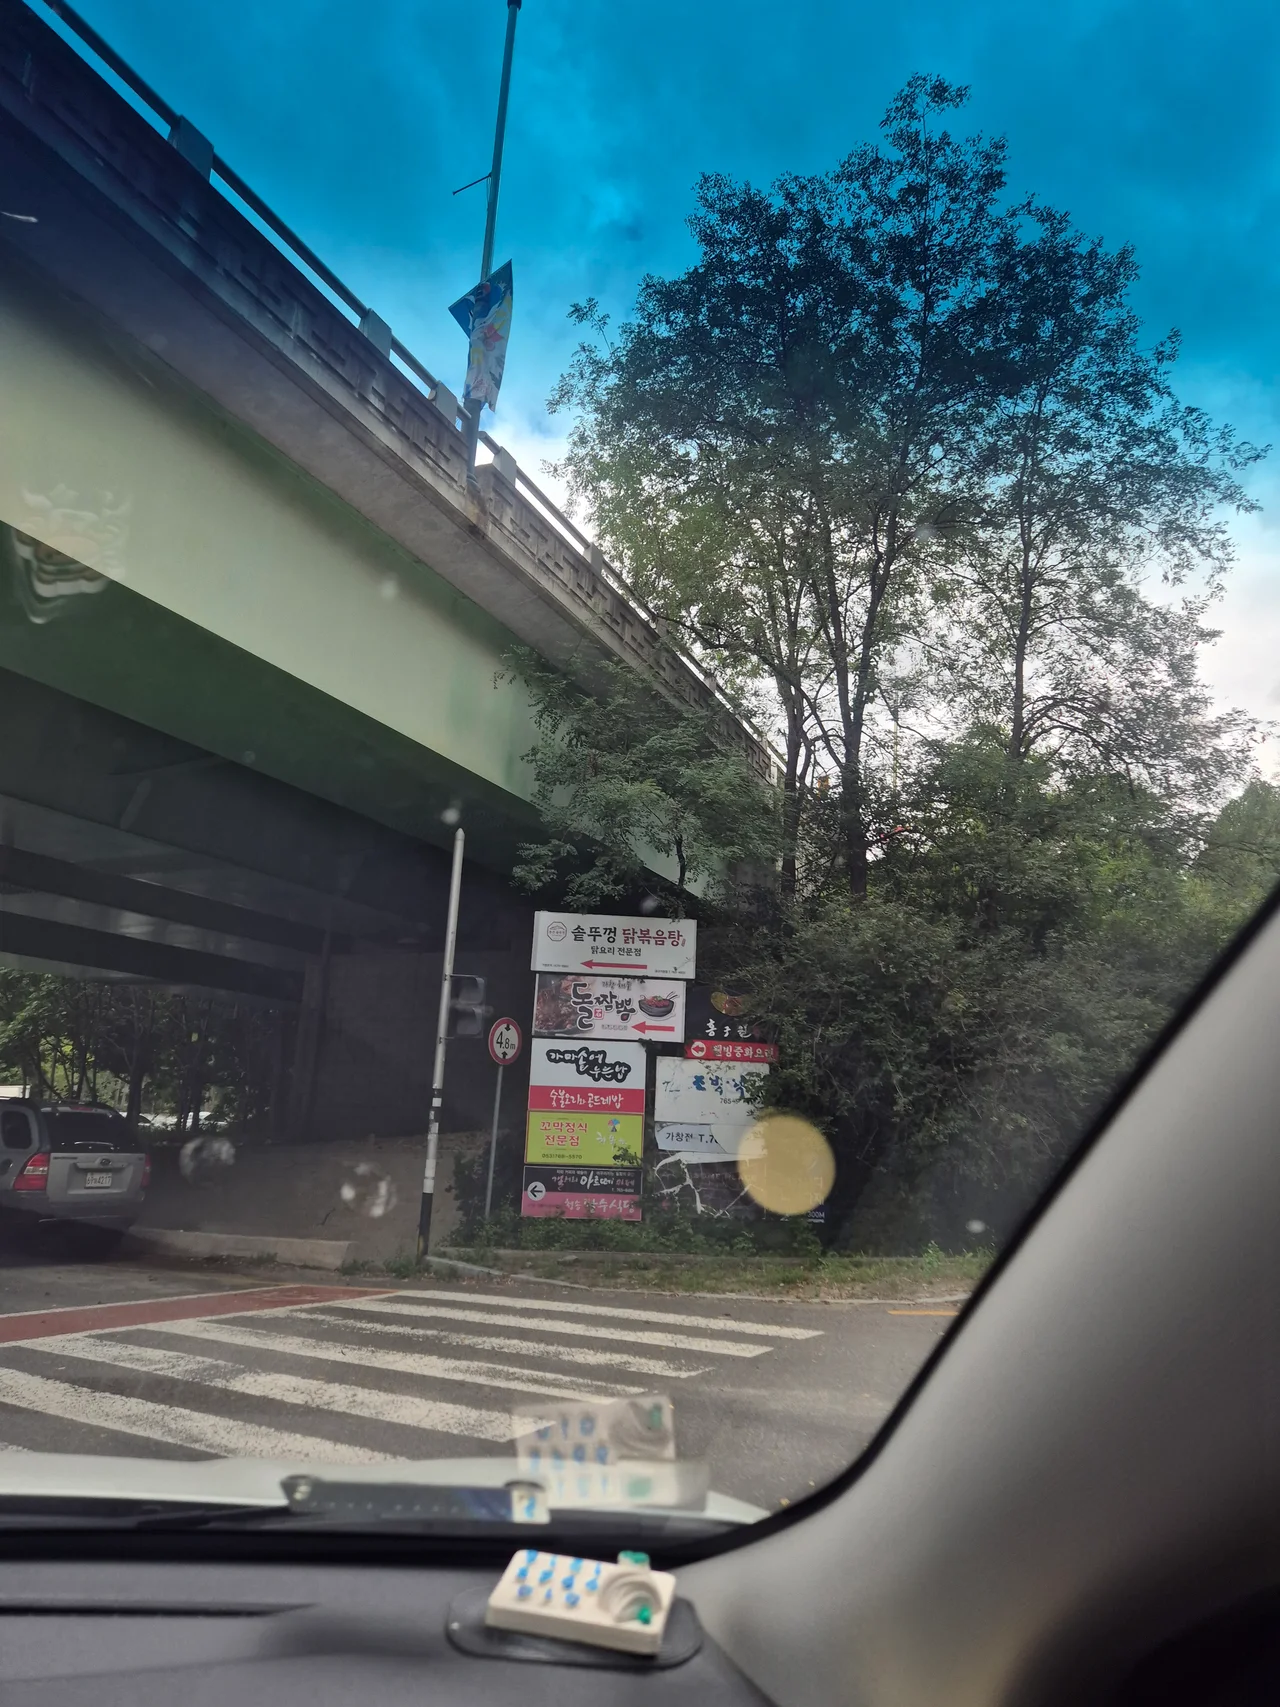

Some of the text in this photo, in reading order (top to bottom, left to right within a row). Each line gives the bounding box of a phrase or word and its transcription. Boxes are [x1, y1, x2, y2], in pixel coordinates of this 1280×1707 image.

[571, 925, 683, 947] 솥뚜껑 닭볶음탕
[591, 946, 642, 956] 닭요리 전문점
[571, 982, 636, 1030] 돌짬뽕
[496, 1031, 516, 1050] 4.8m
[540, 1121, 588, 1133] 꼬막정식
[545, 1135, 580, 1147] 전문점
